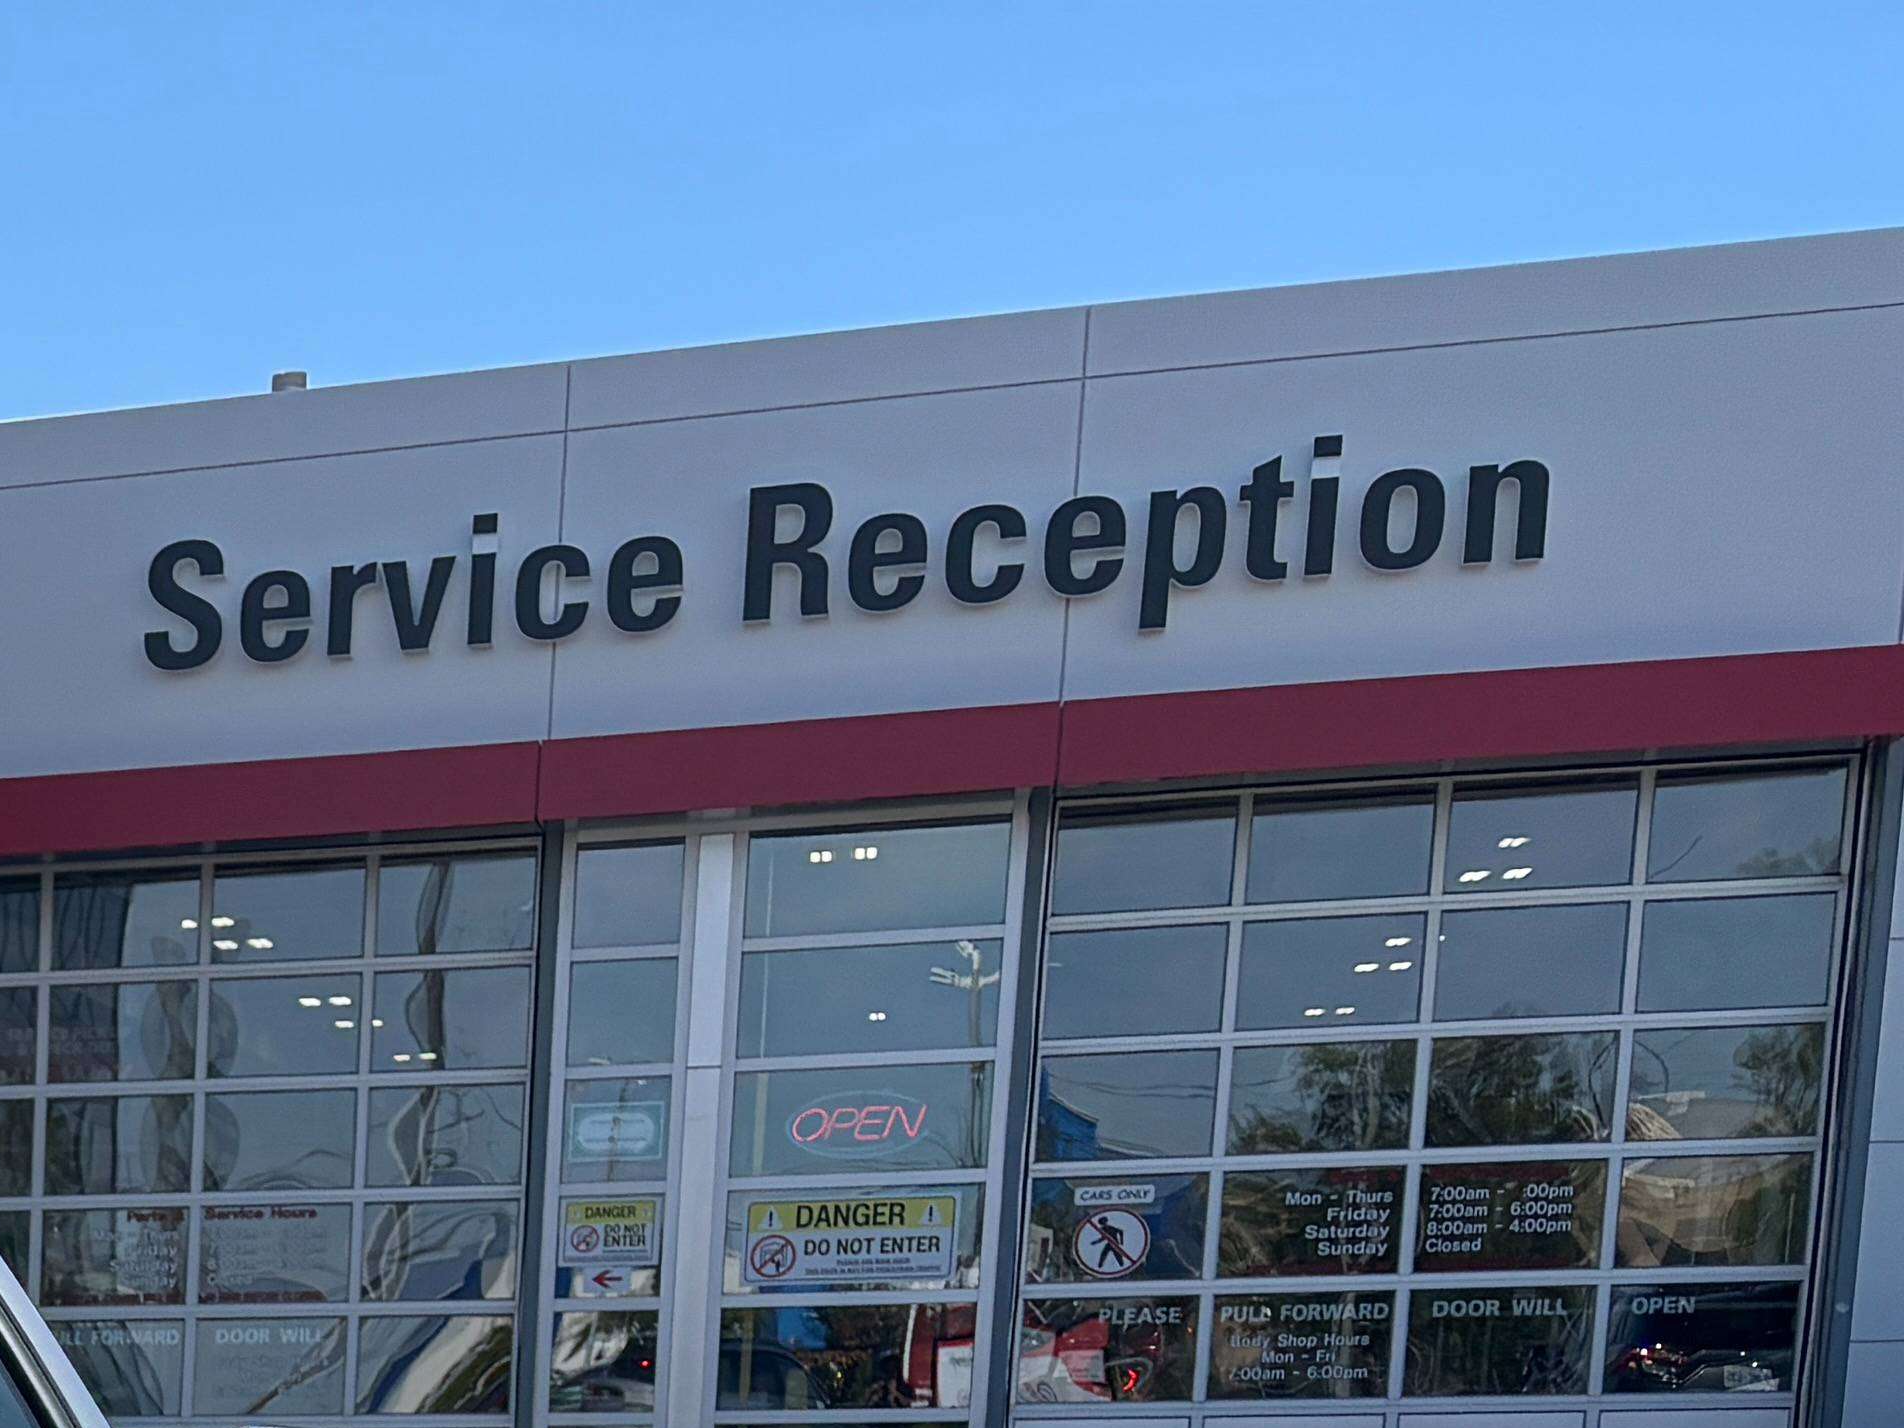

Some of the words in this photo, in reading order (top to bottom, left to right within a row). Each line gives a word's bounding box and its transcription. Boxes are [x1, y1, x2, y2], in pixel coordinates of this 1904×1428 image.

[144, 512, 685, 672] Service
[742, 434, 1552, 631] Reception
[792, 1104, 928, 1142] OPEN
[1080, 1190, 1112, 1201] CARS
[1118, 1189, 1150, 1201] ONLY
[1285, 1192, 1322, 1206] Mon
[1346, 1190, 1394, 1204] Thurs
[1431, 1186, 1490, 1201] 7:00am
[1518, 1183, 1574, 1200] :00pm
[204, 1206, 264, 1221] Service
[271, 1206, 318, 1220] Hours
[584, 1206, 636, 1220] DANGER
[796, 1202, 905, 1229] DANGER
[1327, 1207, 1390, 1222] Friday
[1429, 1204, 1488, 1218] 7:00am
[1510, 1201, 1573, 1217] 6:00pm
[604, 1224, 618, 1235] DO
[623, 1223, 647, 1234] NOT
[1304, 1225, 1389, 1240] Saturday
[1426, 1221, 1488, 1236] 8:00am
[1508, 1218, 1572, 1234] 4:00pm
[603, 1234, 647, 1248] ENTER
[804, 1239, 830, 1256] DO
[836, 1237, 876, 1255] NOT
[880, 1236, 940, 1254] ENTER
[1317, 1242, 1388, 1256] Sunday
[1425, 1238, 1482, 1253] Closed
[1099, 1306, 1182, 1324] PLEASE
[1220, 1305, 1271, 1323] PULL
[1280, 1302, 1390, 1322] FORWARD
[1432, 1299, 1501, 1318] DOOR
[1512, 1297, 1568, 1317] WILL
[1631, 1295, 1696, 1316] OPEN
[215, 1328, 270, 1345] DOOR
[1277, 1333, 1317, 1349] Shop
[1324, 1333, 1370, 1347] Hours
[1261, 1351, 1294, 1364] Mon
[1316, 1350, 1335, 1362] Fri
